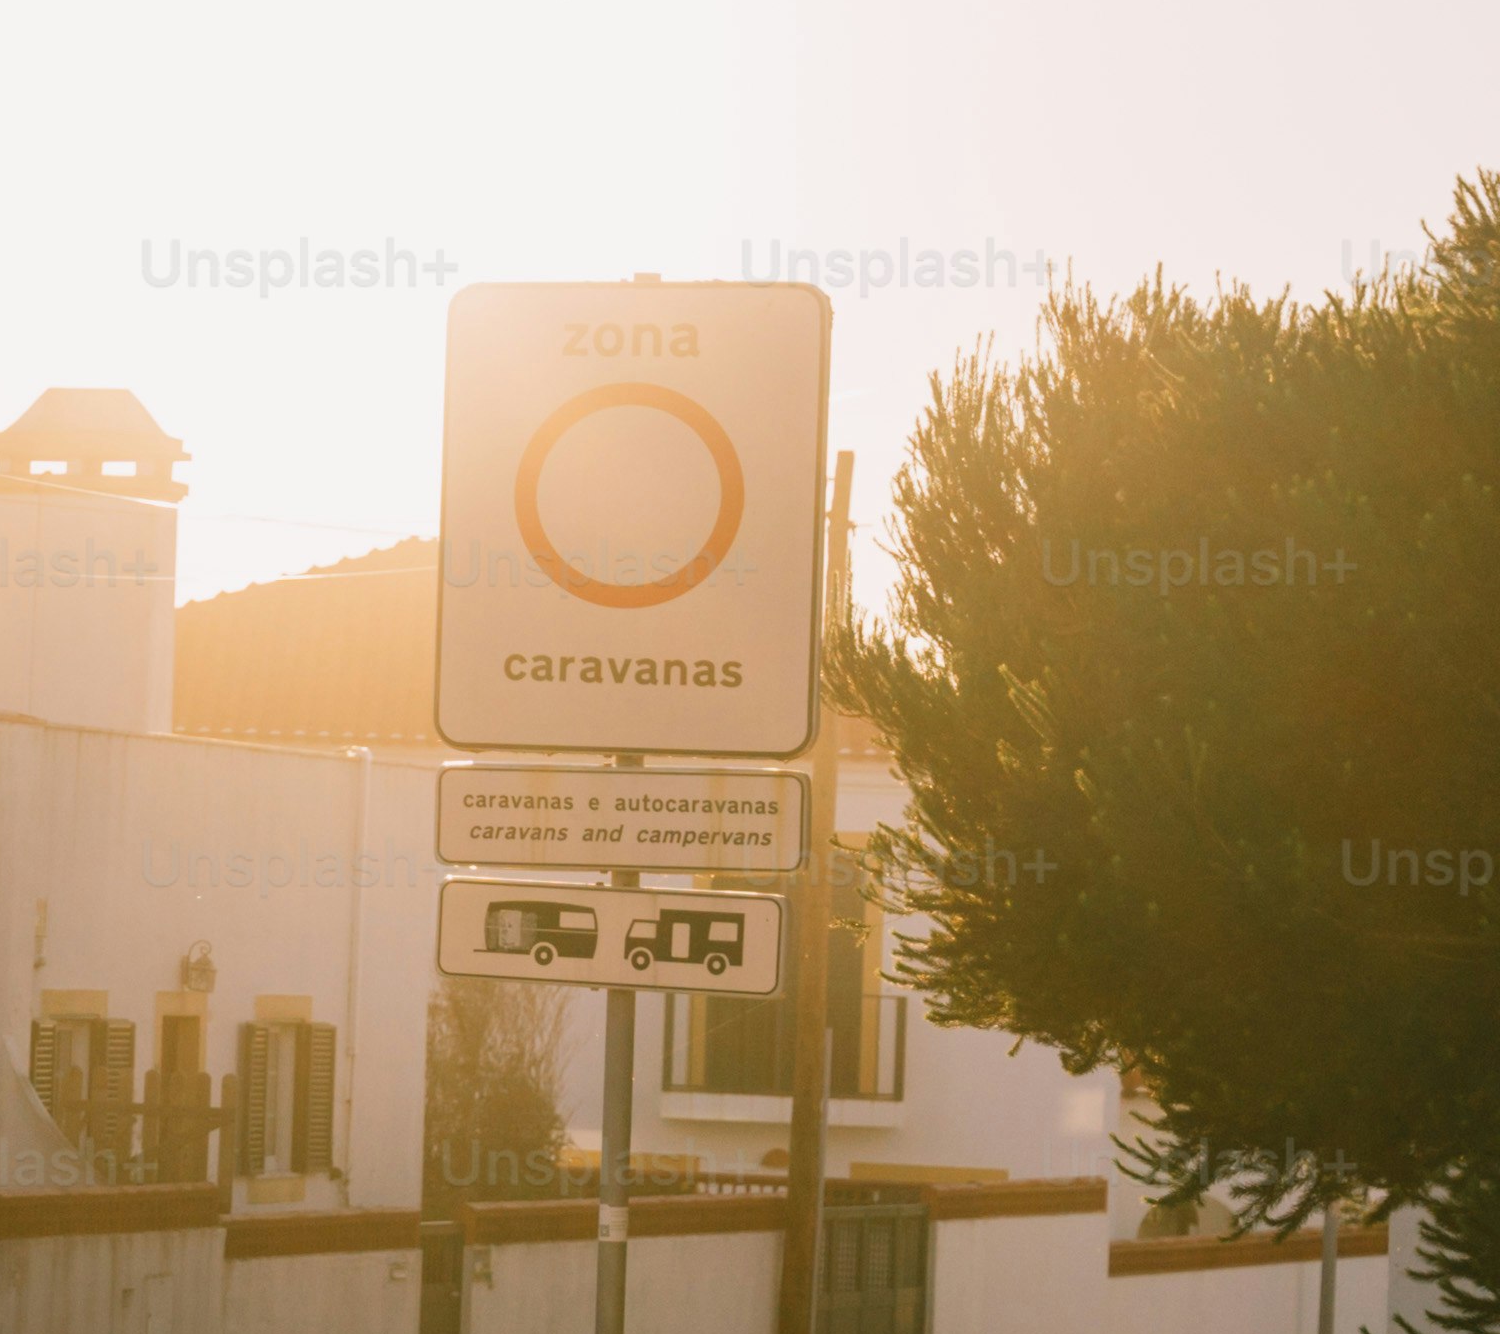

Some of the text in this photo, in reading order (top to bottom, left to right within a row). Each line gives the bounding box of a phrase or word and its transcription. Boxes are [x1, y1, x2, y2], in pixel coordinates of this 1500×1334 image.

[562, 321, 700, 358] zona
[503, 652, 744, 688] caravanas
[462, 791, 779, 815] caravanas e autocaravanas
[469, 823, 773, 848] caravans and campervans
